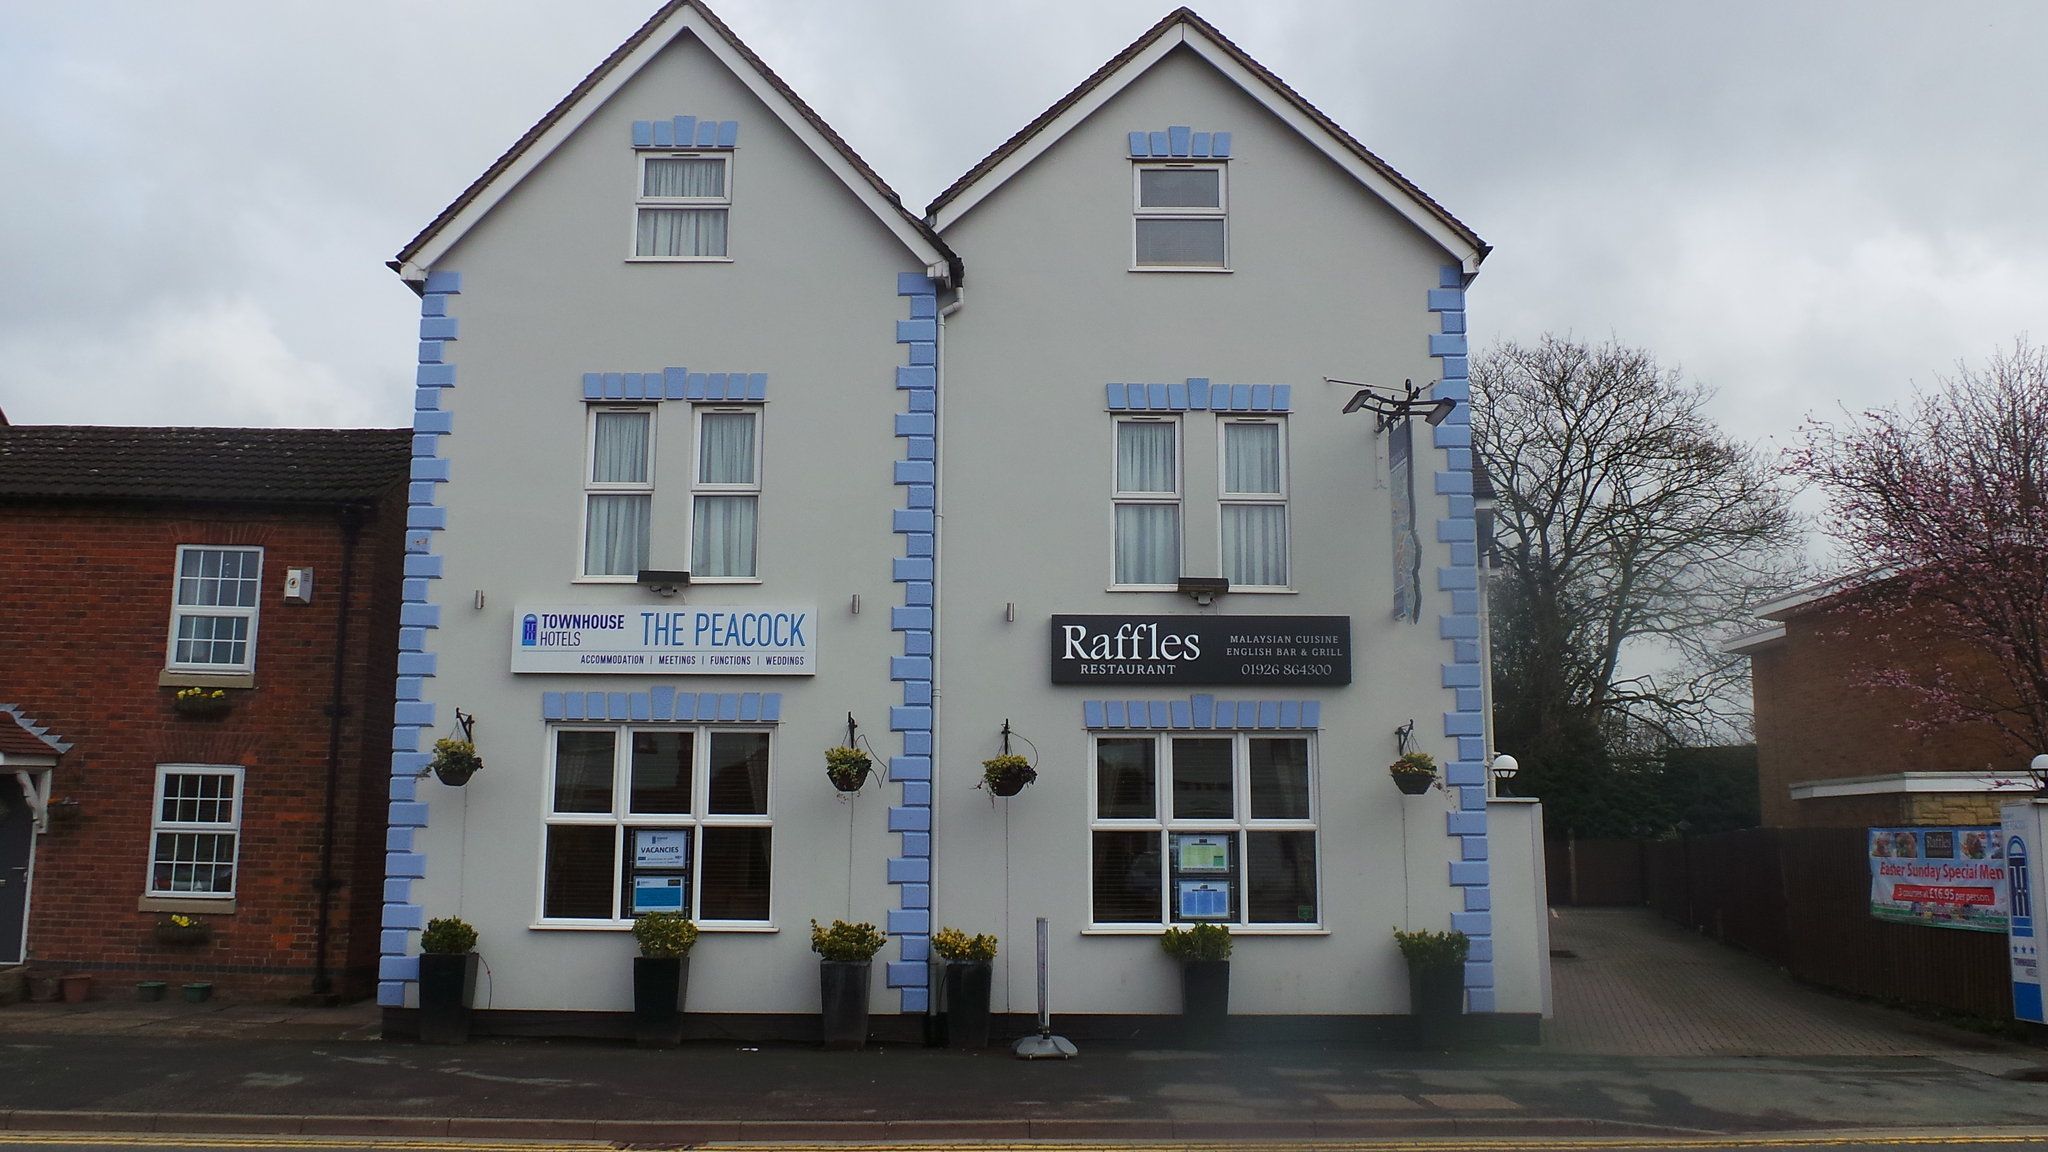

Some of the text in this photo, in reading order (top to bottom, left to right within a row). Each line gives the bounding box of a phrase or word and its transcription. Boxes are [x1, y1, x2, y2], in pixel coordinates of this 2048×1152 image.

[542, 614, 625, 630] TOWNHOUSE
[641, 613, 806, 647] THE PEACOCK
[540, 631, 581, 647] HOTELS
[1062, 623, 1201, 661] Raffles
[1230, 635, 1339, 644] MALAYSIAN CUISINE
[1226, 647, 1343, 656] ENGLISH BAR & GRILL
[580, 655, 645, 665] ACCOMMODATION
[658, 655, 696, 665] MEETINGS
[710, 655, 751, 666] FUNCTIONS
[766, 656, 804, 666] WEDDINGS
[1080, 664, 1177, 675] RESTAURANT
[1241, 664, 1332, 675] 01926 864300
[640, 846, 679, 854] VACANCIES
[1880, 861, 2005, 881] Easter Sunday Special Men
[1929, 887, 1955, 900] £16.95
[1965, 893, 1990, 902] person
